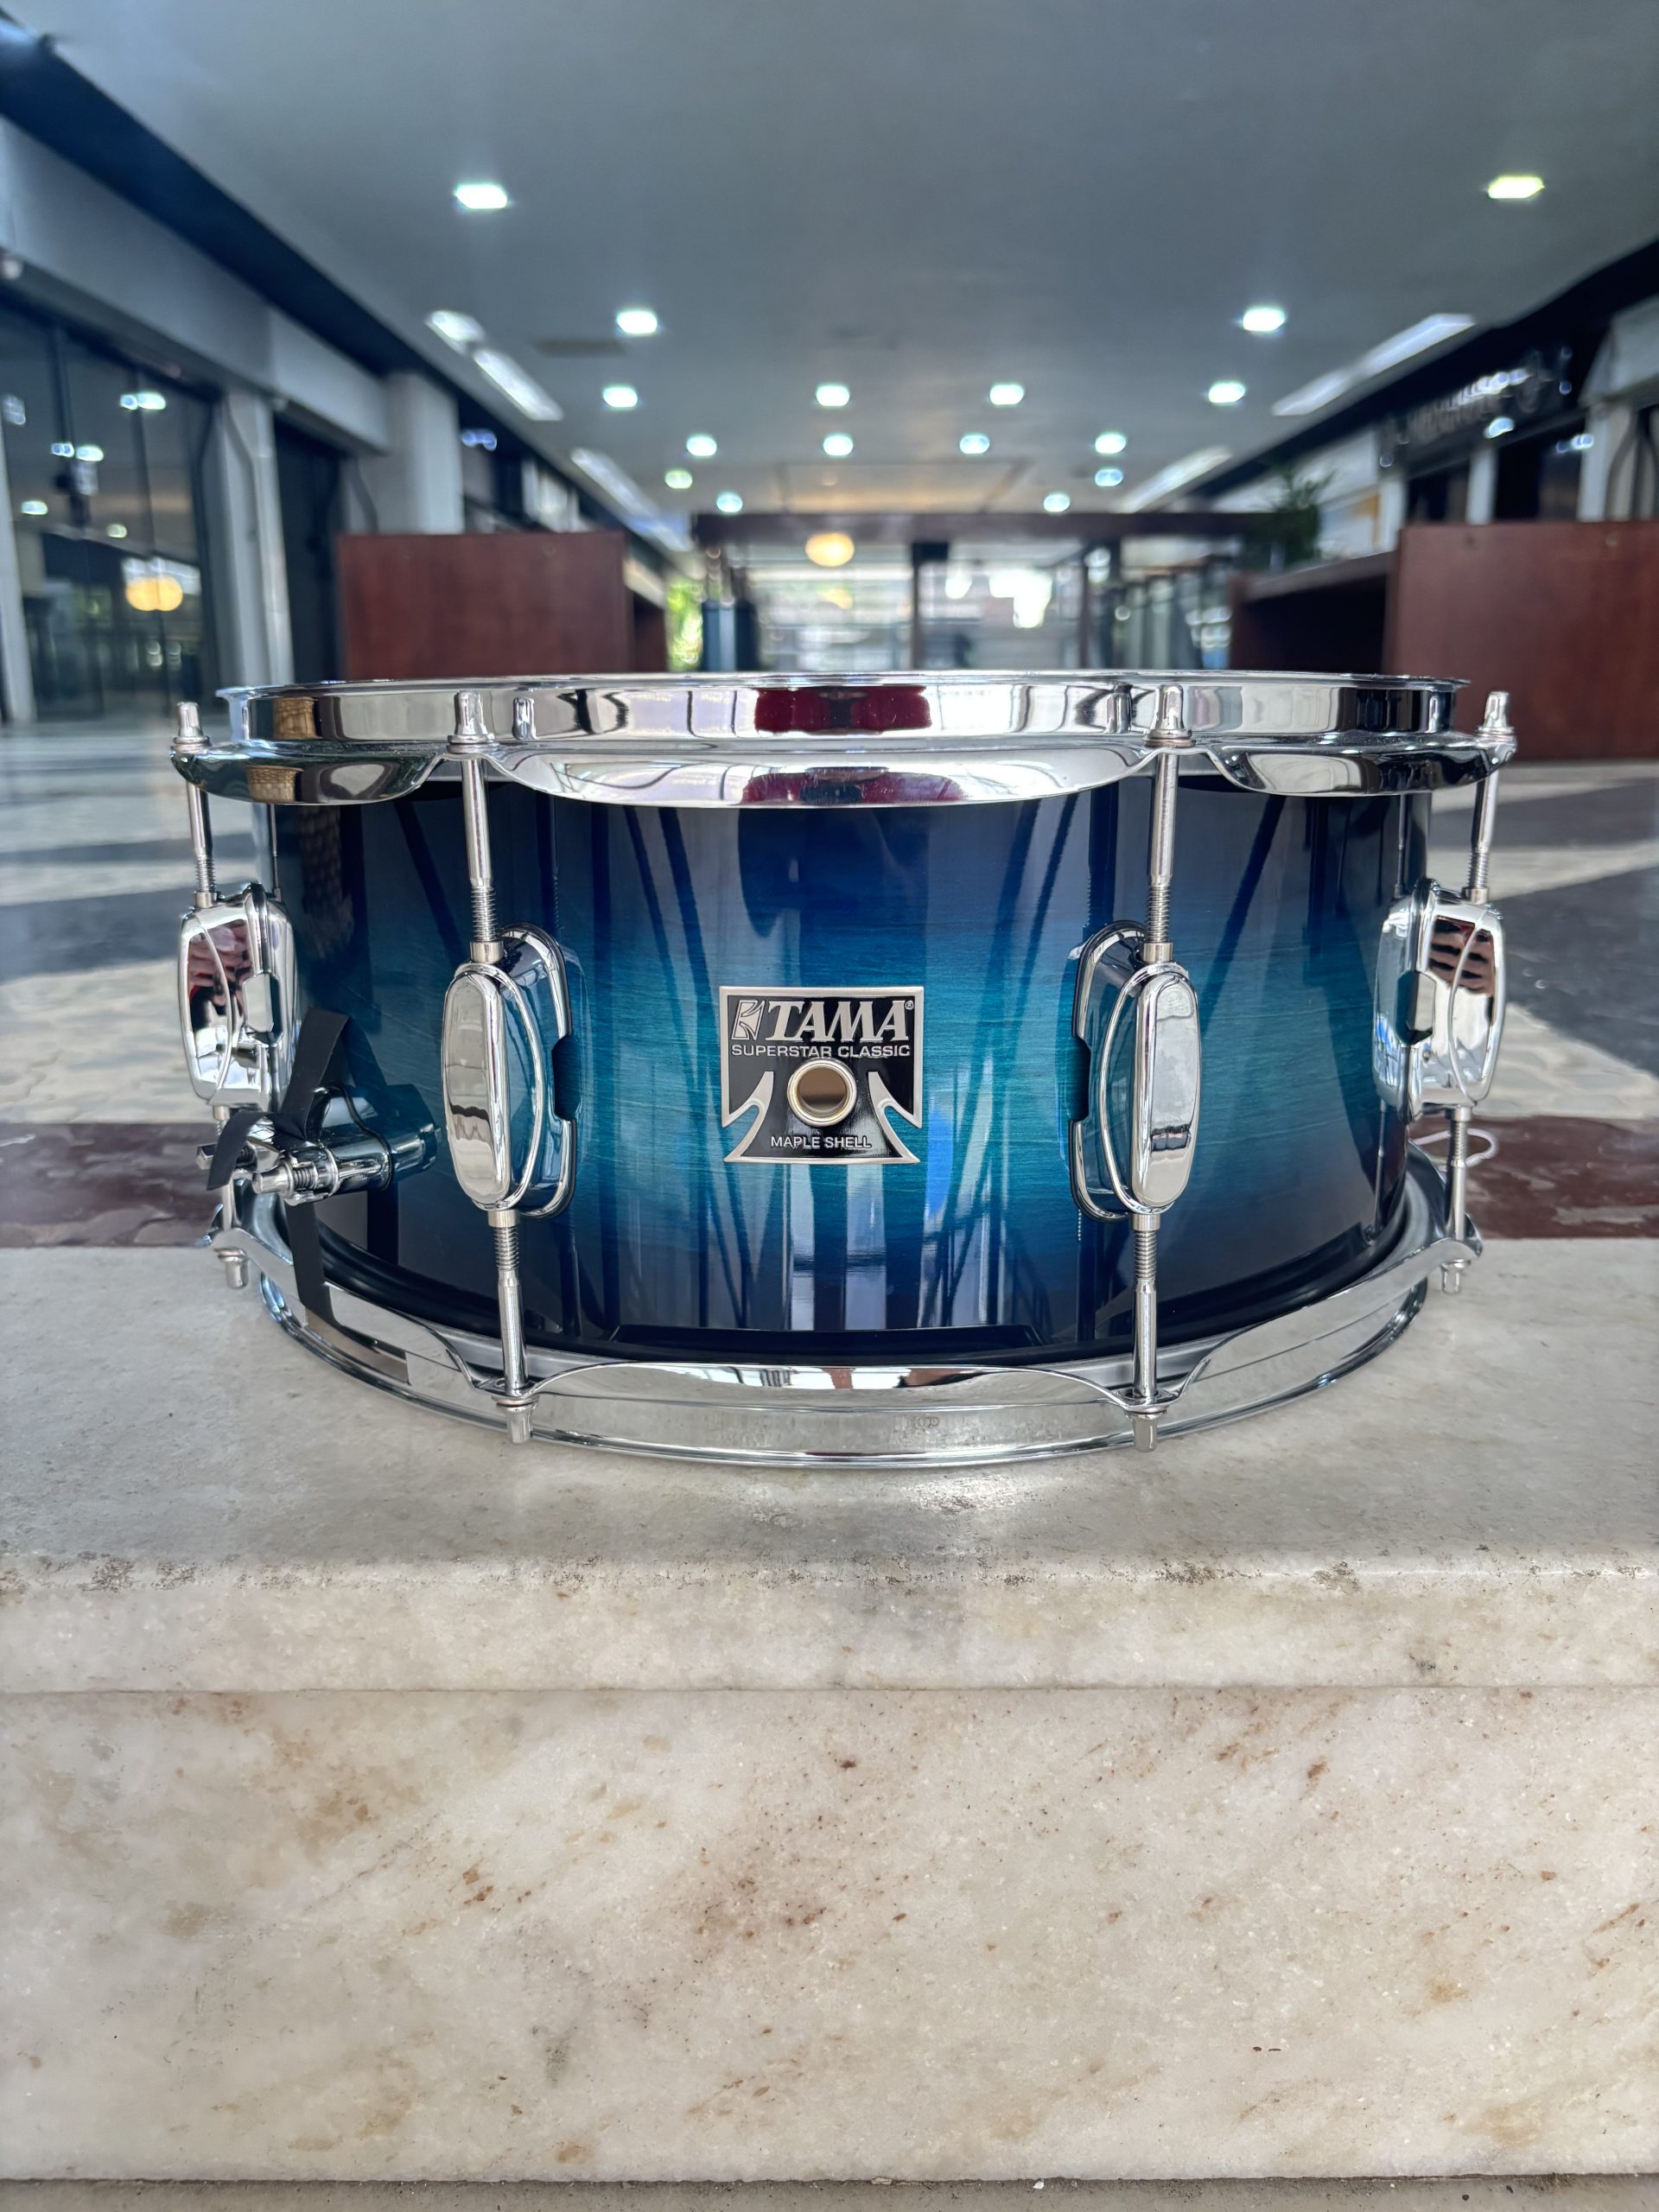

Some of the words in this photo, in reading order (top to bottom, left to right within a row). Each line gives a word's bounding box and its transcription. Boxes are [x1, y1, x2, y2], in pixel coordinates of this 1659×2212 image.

[731, 1044, 832, 1057] SUPERSTAR
[837, 1045, 911, 1058] CLASSIC
[771, 1136, 820, 1148] MAPLE
[823, 1136, 872, 1148] SHELL
